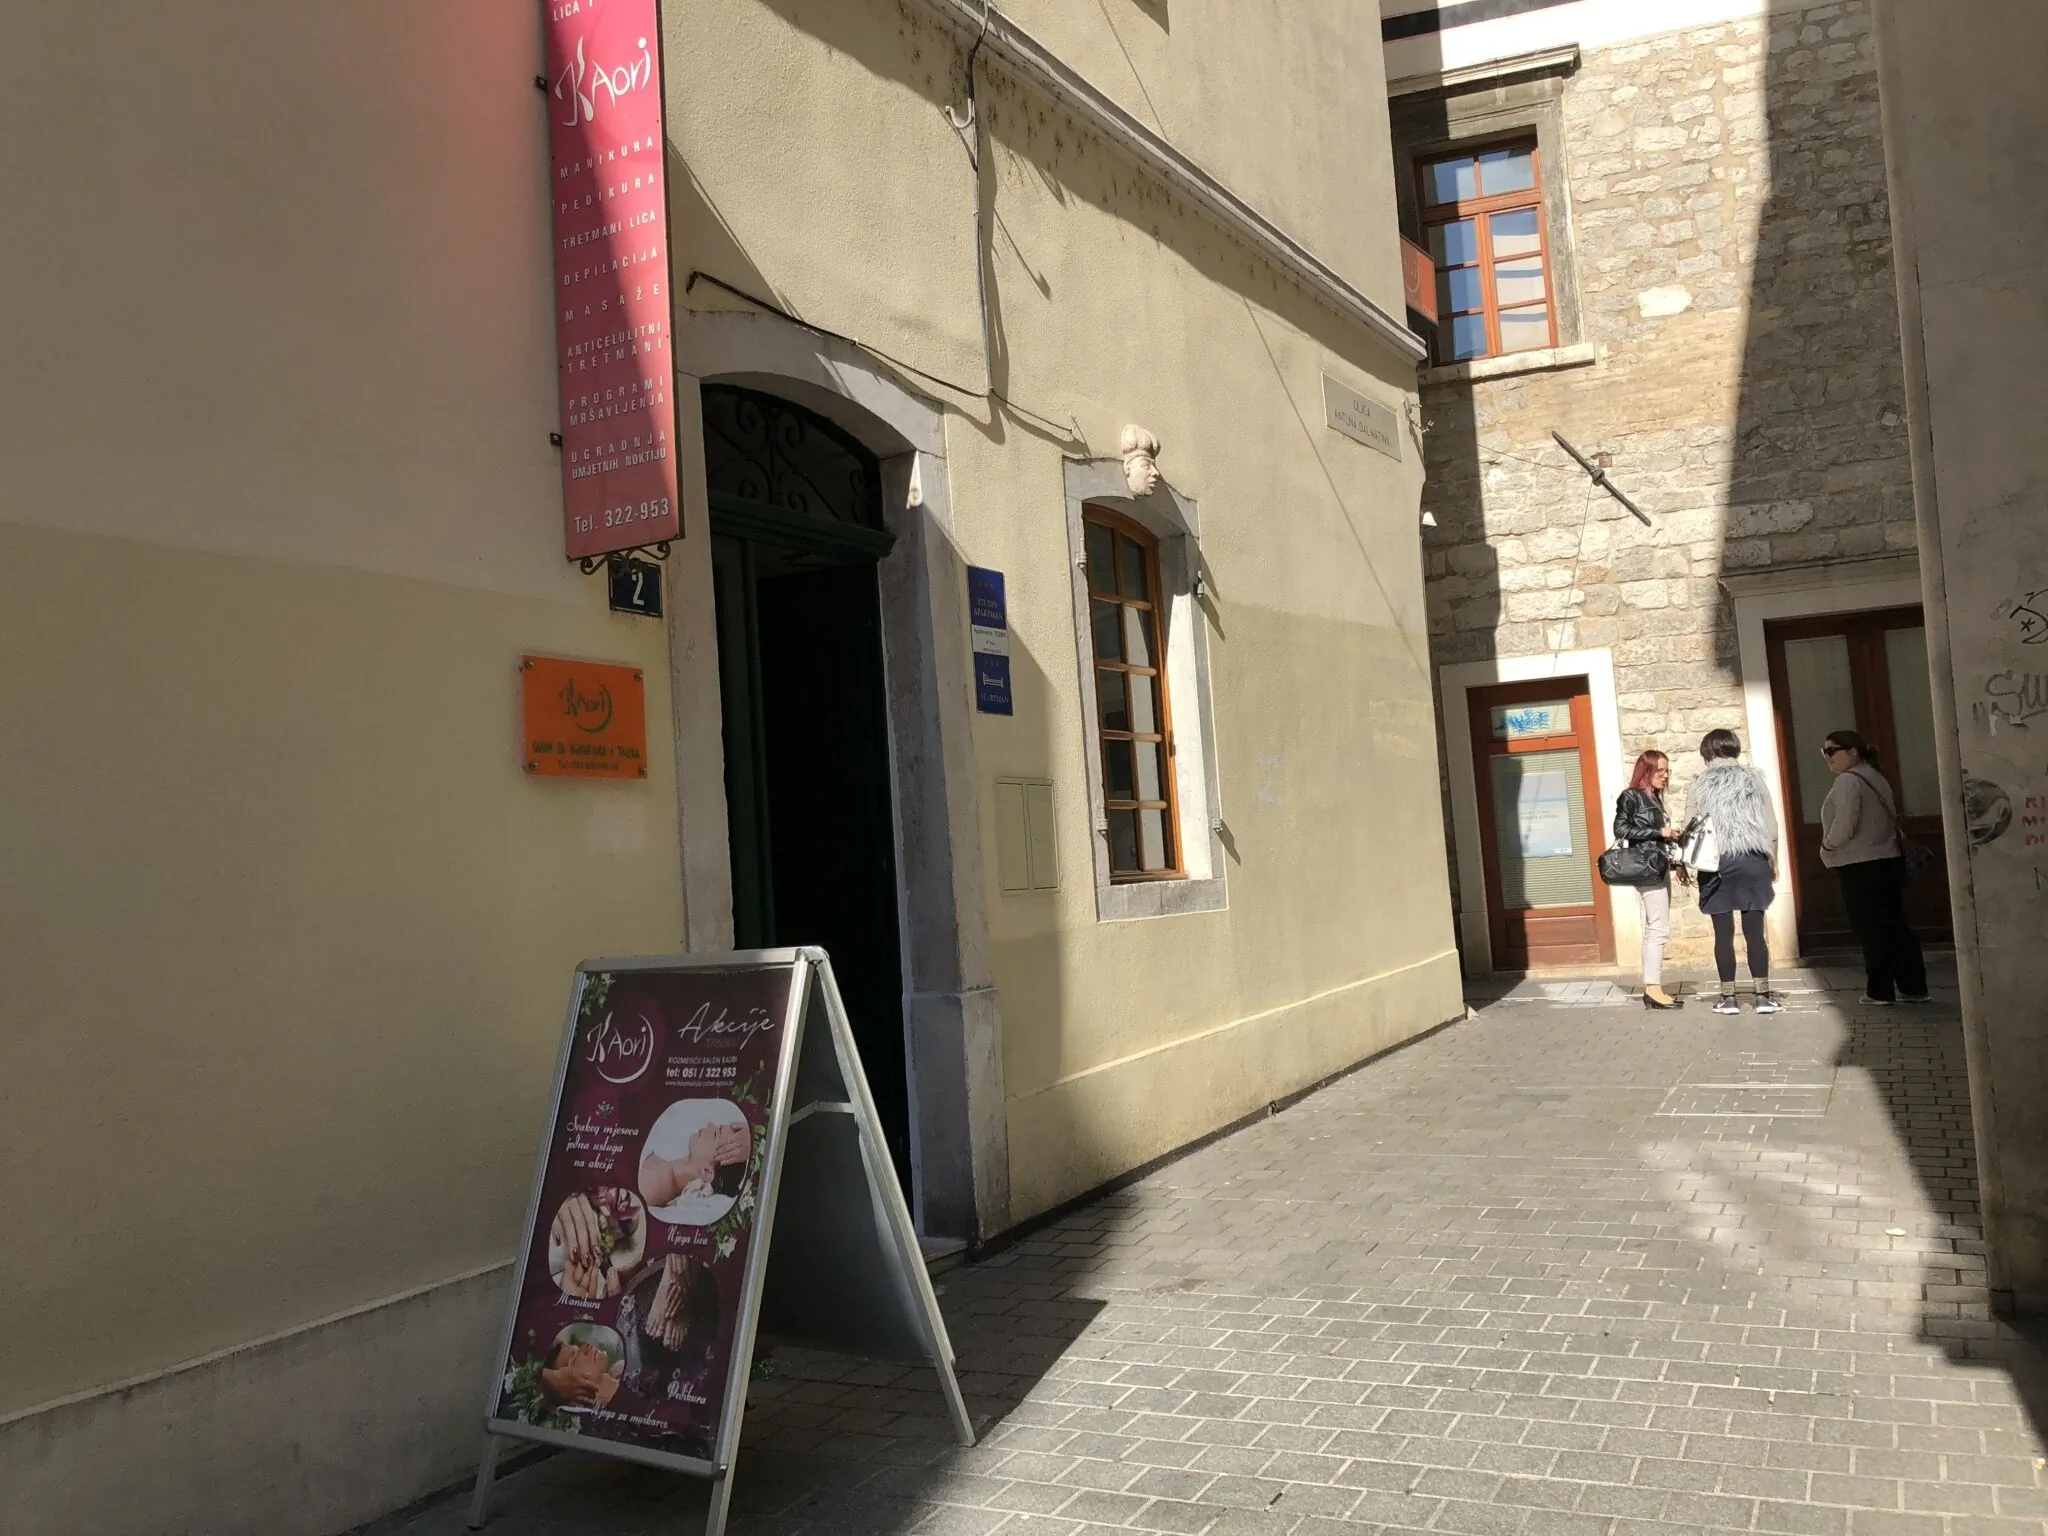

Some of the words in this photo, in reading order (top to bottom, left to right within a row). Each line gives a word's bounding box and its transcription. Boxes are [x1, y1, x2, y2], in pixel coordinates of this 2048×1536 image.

[553, 2, 580, 22] LICA
[560, 136, 653, 179] MANIKURA
[561, 173, 655, 214] PEDIKURA
[562, 222, 621, 250] TRETMANI
[629, 210, 656, 229] LICA
[564, 247, 657, 285] DEPILACIJA
[565, 283, 660, 321] MASAŽE
[567, 321, 661, 358] ANTICELULITNI
[568, 338, 662, 374] TRETMANI
[569, 376, 664, 410] PROGRAMI
[569, 392, 664, 426] MRŠAVLJENJA
[571, 430, 666, 463] UGRADNJA
[572, 455, 618, 480] UMJETNIH
[626, 447, 666, 467] NOKTIJU
[574, 514, 598, 535] Tel.
[605, 498, 669, 528] 322-953
[631, 570, 645, 605] 2
[677, 1001, 775, 1050] Akcije
[666, 1067, 680, 1077] tel:
[682, 1067, 697, 1078] 051
[705, 1067, 720, 1078] 322
[722, 1066, 736, 1077] 953
[566, 1134, 589, 1152] jedna
[593, 1135, 623, 1155] usluga
[603, 1123, 639, 1137] mjeseca
[589, 1153, 614, 1173] akciji
[668, 1224, 690, 1246] Njega
[553, 1290, 601, 1309] Manikura
[667, 1380, 707, 1404] Pedikura
